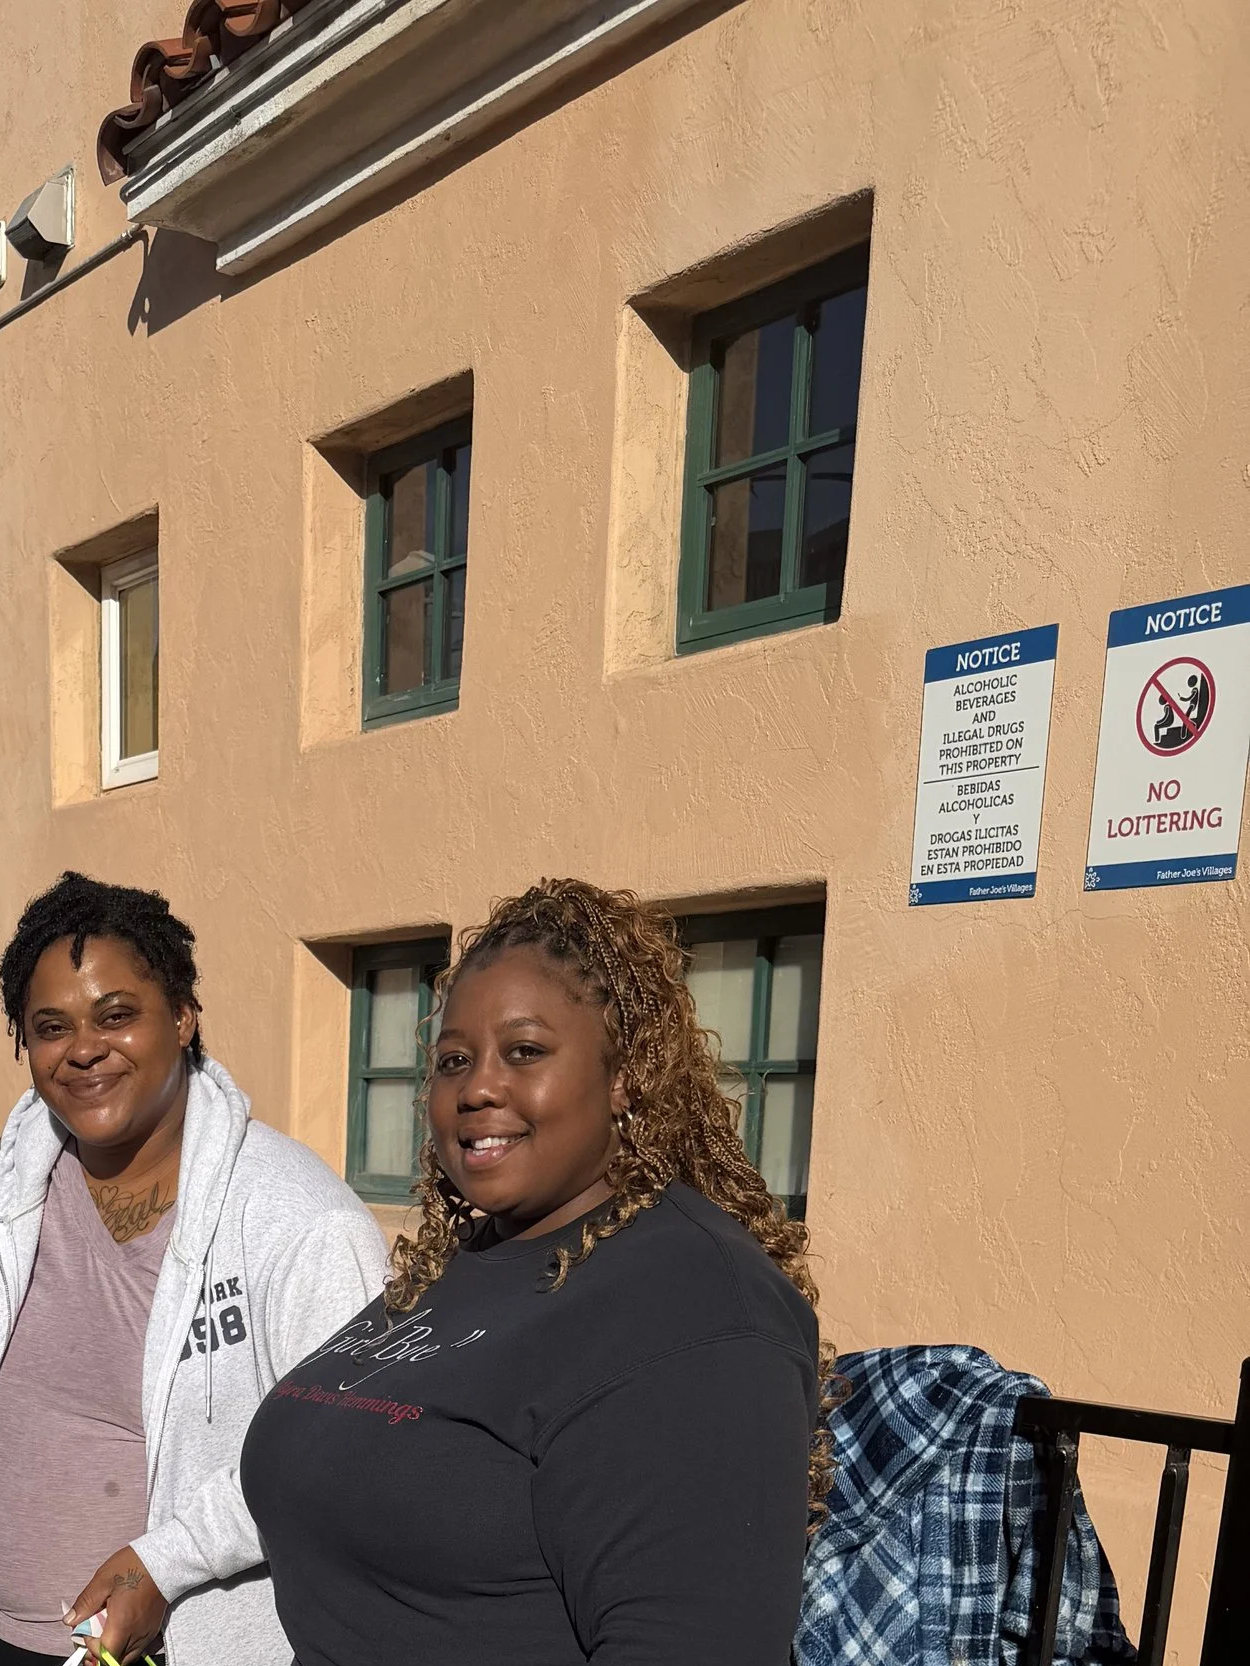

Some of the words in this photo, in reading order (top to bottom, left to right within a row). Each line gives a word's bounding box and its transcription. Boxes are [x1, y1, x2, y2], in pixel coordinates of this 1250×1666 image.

[1144, 602, 1223, 635] NOTICE
[955, 642, 1021, 672] NOTICE
[953, 674, 1018, 697] ALCOHOLIC
[955, 690, 1017, 712] BEVERAGES
[971, 710, 996, 725] AND
[942, 728, 985, 745] ILLEGAL
[987, 721, 1025, 738] DRUGS
[939, 740, 1003, 761] PROHIBITED
[1006, 737, 1024, 750] ON
[939, 762, 963, 776] THIS
[965, 753, 1022, 773] PROPERTY
[957, 779, 1001, 796] BEBIDAS
[1146, 779, 1181, 803] NO
[938, 793, 1015, 814] ALCOHOLICAS
[972, 813, 981, 825] Y
[1107, 807, 1223, 838] LOITERING
[930, 829, 972, 845] DROGAS
[974, 824, 1019, 840] ILICITAS
[927, 846, 959, 861] ESTAN
[962, 840, 1022, 857] PROHIBIDO
[920, 864, 935, 876] EN
[936, 861, 961, 875] ESTA
[963, 855, 1024, 872] PROPIEDAD
[1156, 870, 1181, 880] Father
[1181, 867, 1201, 878] Joe's
[1201, 866, 1233, 877] Villages
[969, 886, 990, 896] Father
[990, 885, 1006, 894] Joe's
[1007, 883, 1033, 894] Villages
